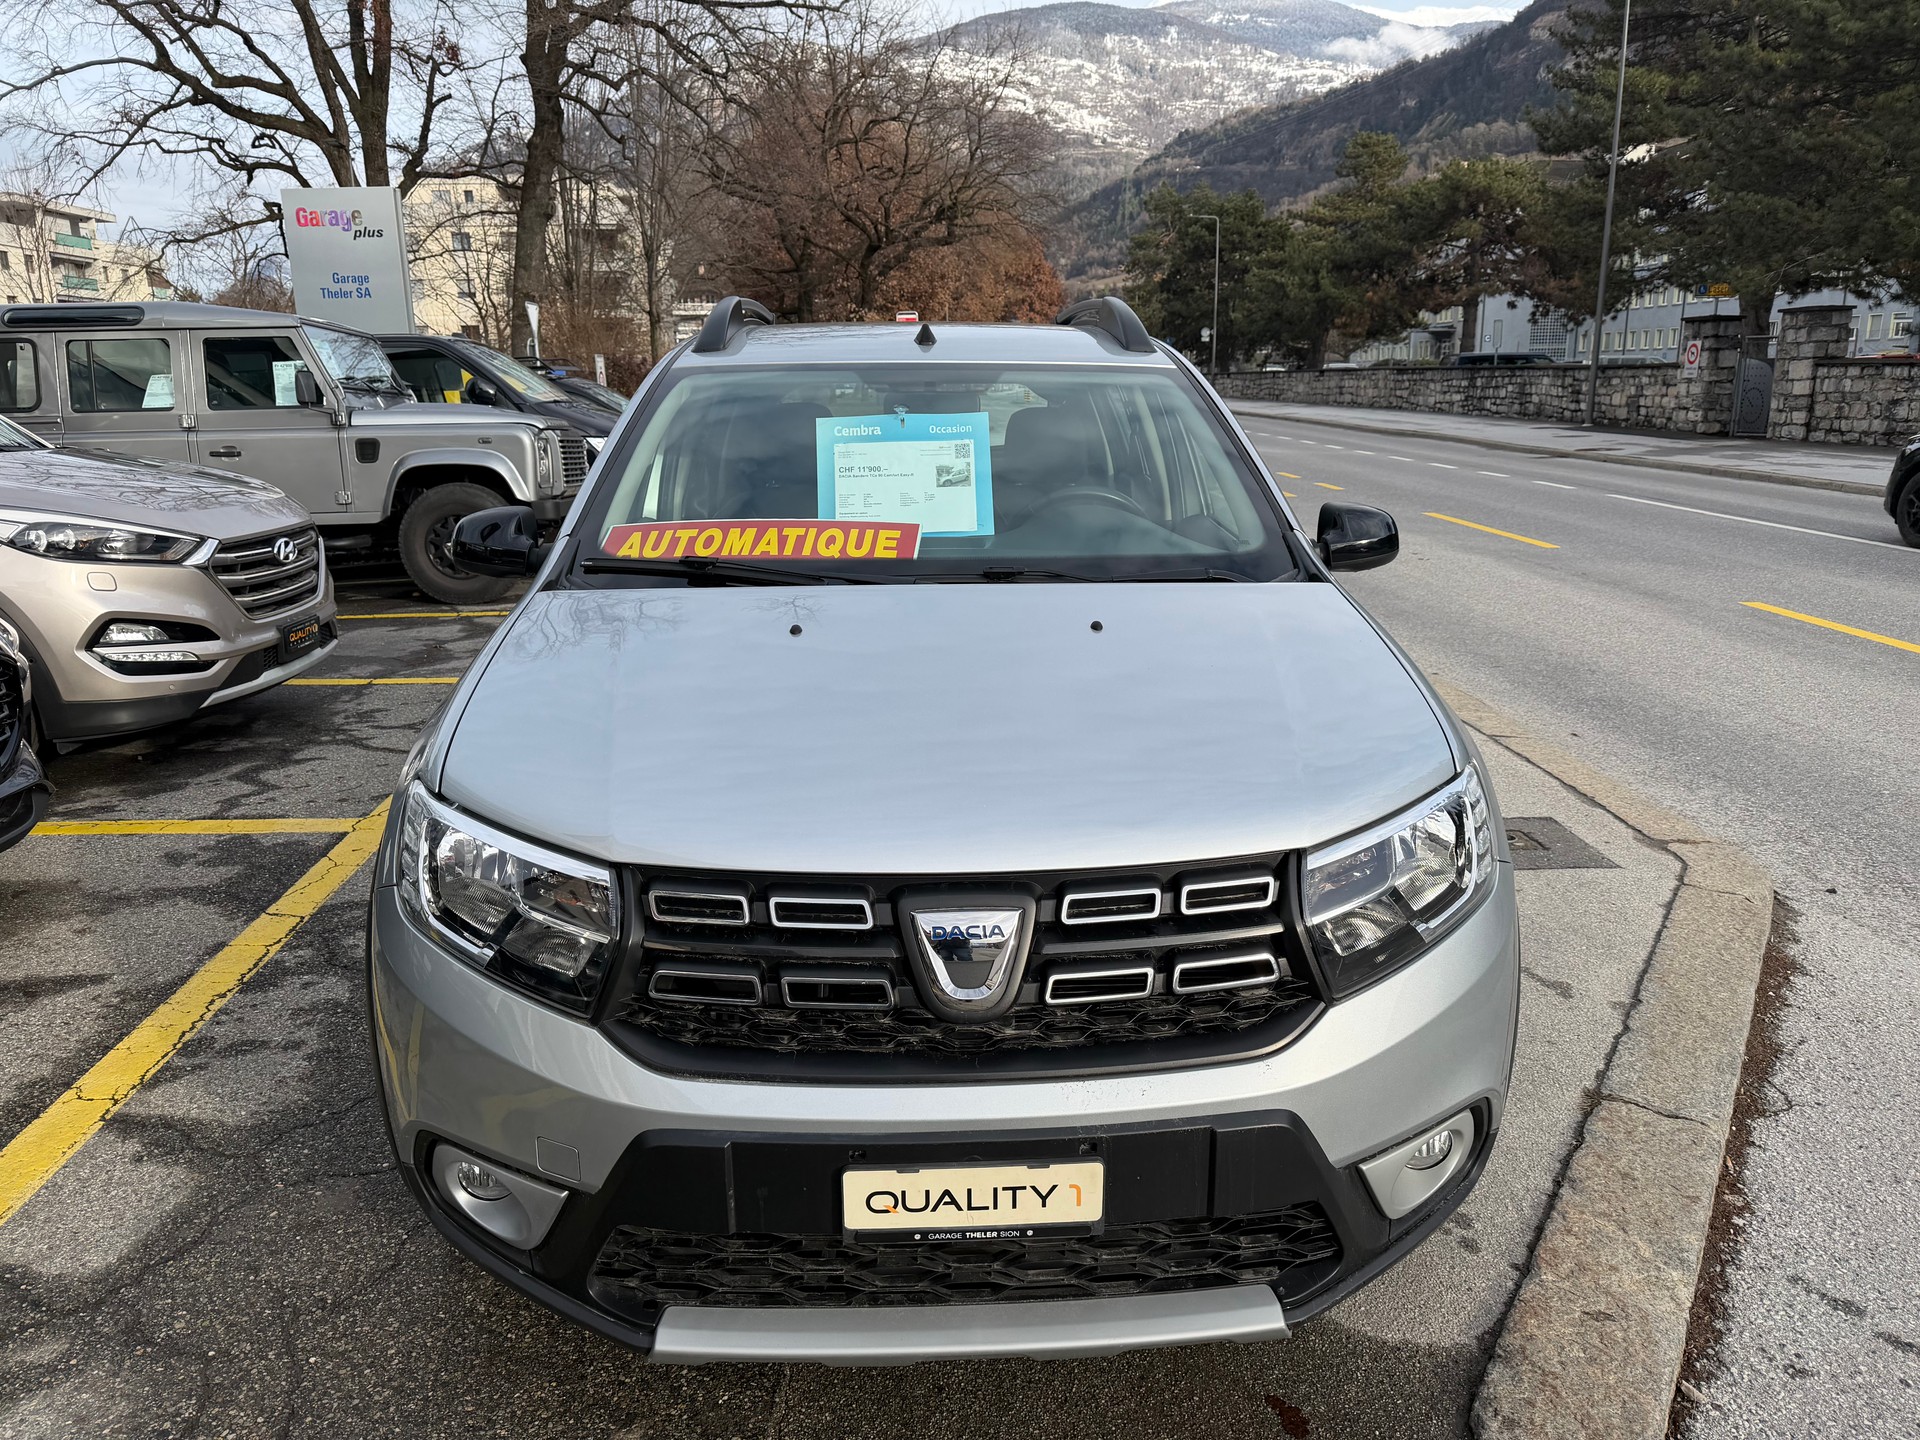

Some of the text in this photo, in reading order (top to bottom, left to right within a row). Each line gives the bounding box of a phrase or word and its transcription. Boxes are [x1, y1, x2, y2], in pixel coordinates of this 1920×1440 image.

[295, 207, 363, 232] Garage
[353, 226, 384, 240] plus
[332, 272, 370, 286] Garage
[320, 287, 371, 299] Theler SA
[834, 424, 973, 436] Cembra Occasion
[616, 527, 902, 559] AUTOMATIQUE
[931, 924, 1006, 941] DACIA
[865, 1183, 1082, 1214] QUALITY 1
[928, 1230, 1020, 1240] GARAGE THELER SION
